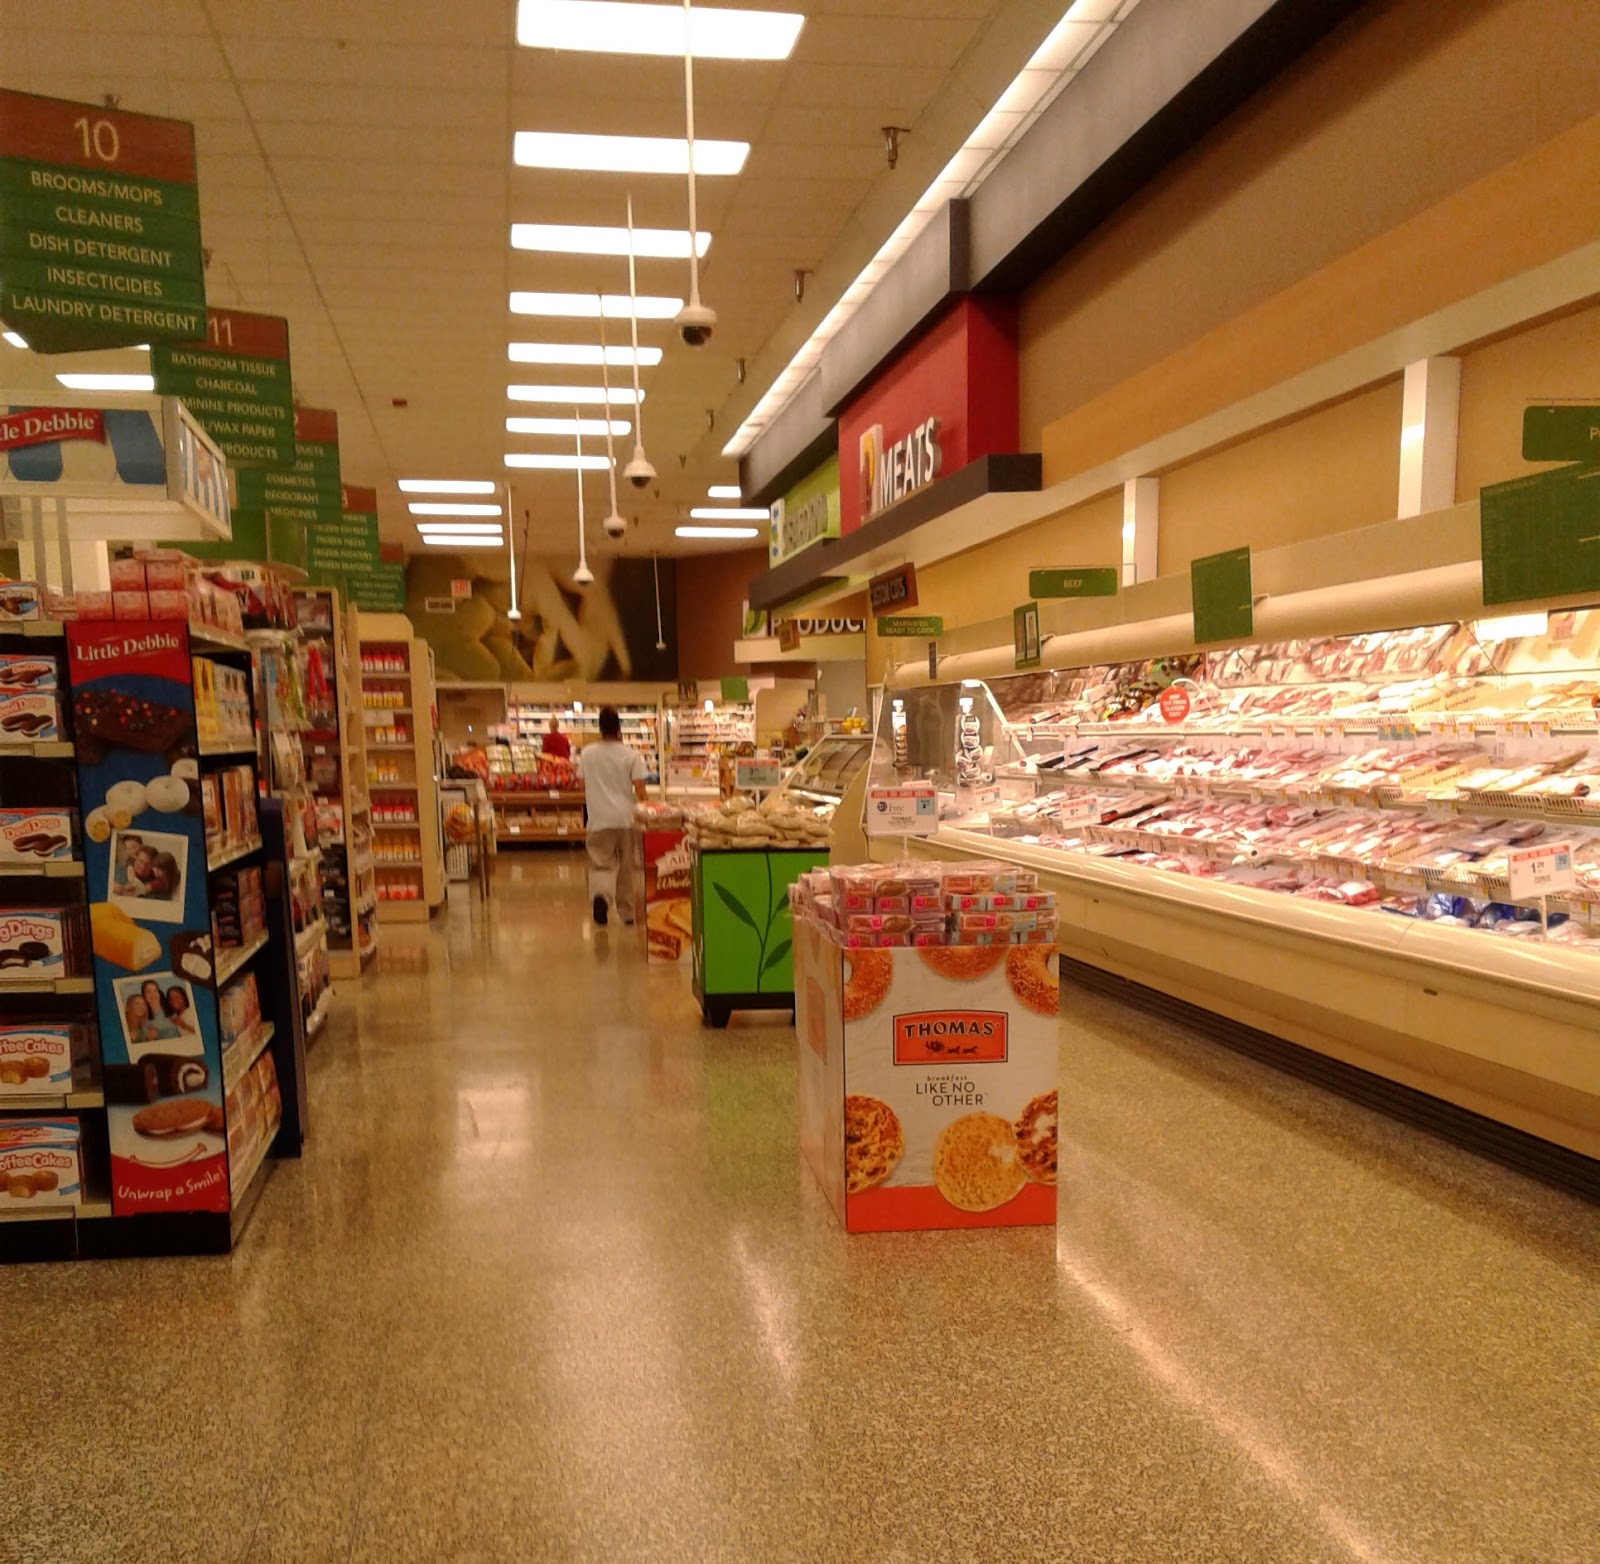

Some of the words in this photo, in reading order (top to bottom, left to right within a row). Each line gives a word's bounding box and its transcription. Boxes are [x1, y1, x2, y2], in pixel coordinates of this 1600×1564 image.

[74, 117, 120, 162] 10
[31, 170, 163, 206] BROOMS/MOPS
[55, 206, 144, 233] CLEANERS
[29, 232, 69, 253] DISH
[74, 239, 173, 268] DETERGENT
[47, 267, 163, 297] INSECTICIDES
[12, 294, 95, 318] LAUNDRY
[100, 304, 198, 331] DETERGENT
[208, 316, 233, 347] 11
[171, 352, 237, 371] BATHROOM
[241, 361, 276, 377] TISSUE
[196, 377, 257, 396] CHARCOAL
[227, 401, 286, 419] PRODUCTS
[24, 411, 94, 437] Debbie
[242, 424, 275, 438] PAPER
[880, 417, 935, 510] MEATS
[1063, 579, 1083, 588] BEEF
[76, 643, 120, 661] Little
[123, 633, 180, 655] Debbie
[3, 821, 33, 840] Devil
[31, 818, 60, 832] Dogs
[916, 1082, 947, 1095] LIKE
[952, 1081, 976, 1093] NO
[926, 1074, 968, 1082] breakfast
[932, 1094, 984, 1107] OTHER
[118, 1184, 172, 1202] Unwrap
[175, 1185, 185, 1197] a
[185, 1164, 225, 1194] Smile!
